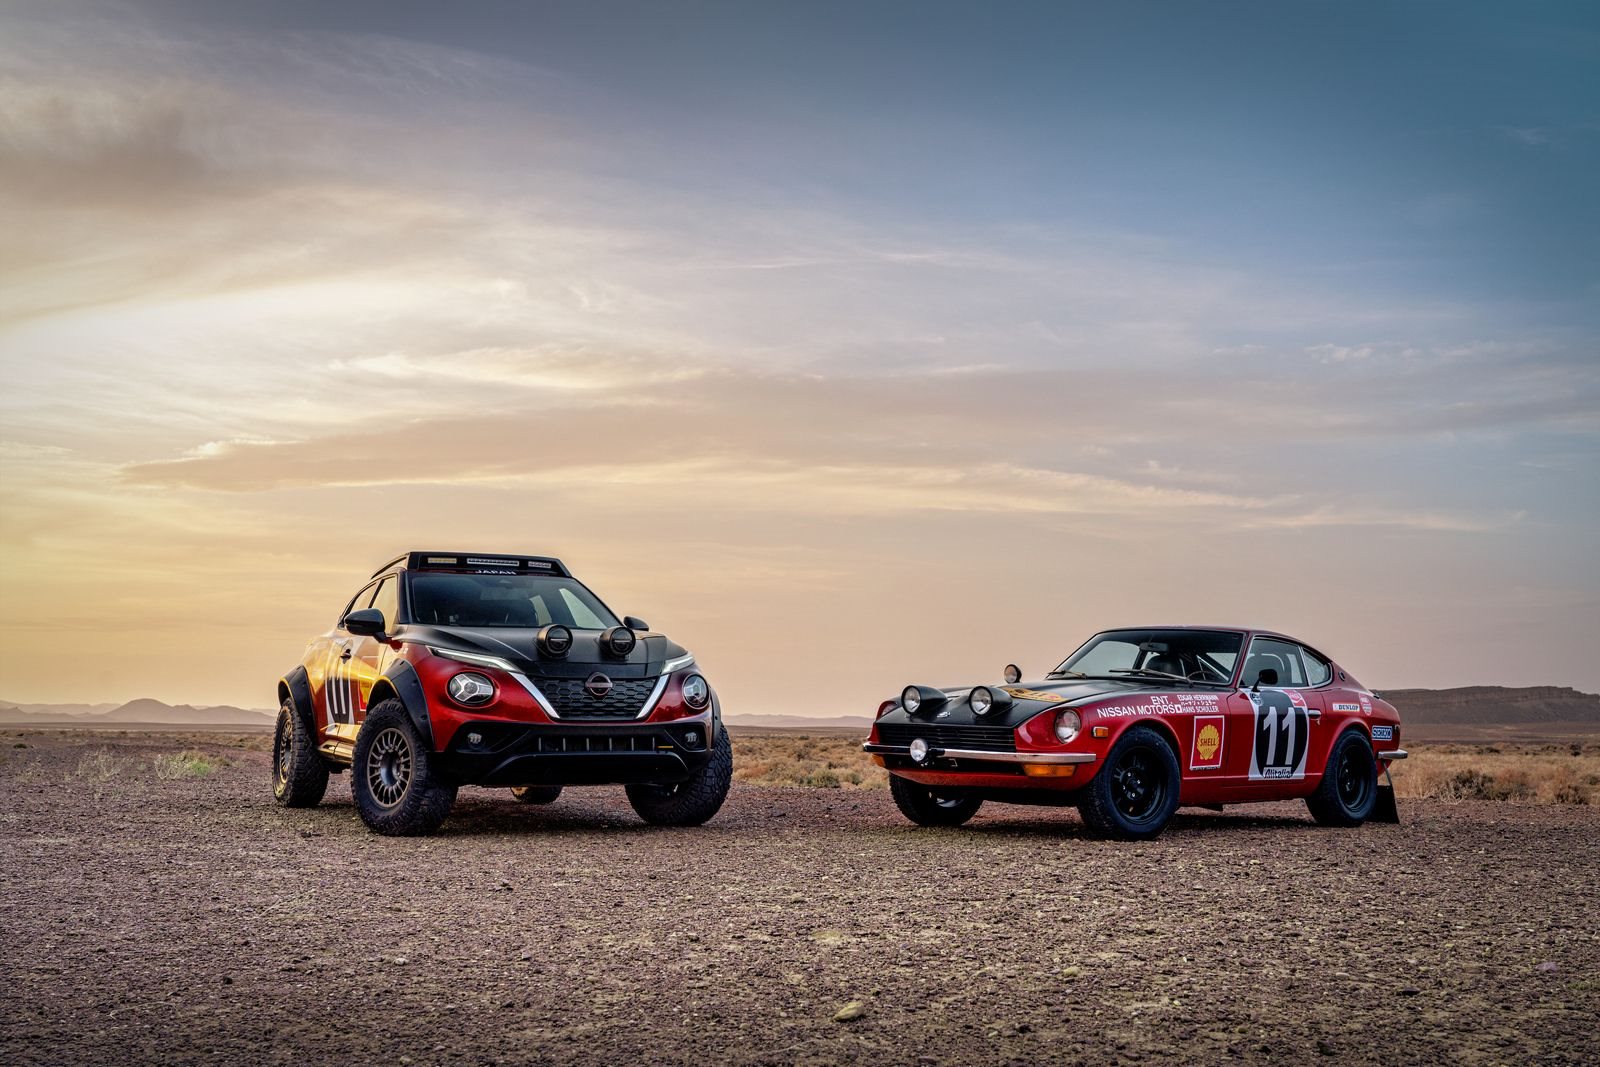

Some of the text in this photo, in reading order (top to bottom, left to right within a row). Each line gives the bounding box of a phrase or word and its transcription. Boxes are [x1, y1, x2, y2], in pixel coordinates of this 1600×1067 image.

[1097, 704, 1175, 718] NISSAN MOTORS
[1183, 705, 1196, 713] HANS
[1263, 706, 1296, 765] 11
[1372, 728, 1392, 739] SEIKO
[1200, 738, 1216, 746] SHELL
[1264, 768, 1293, 778] Alitalia
